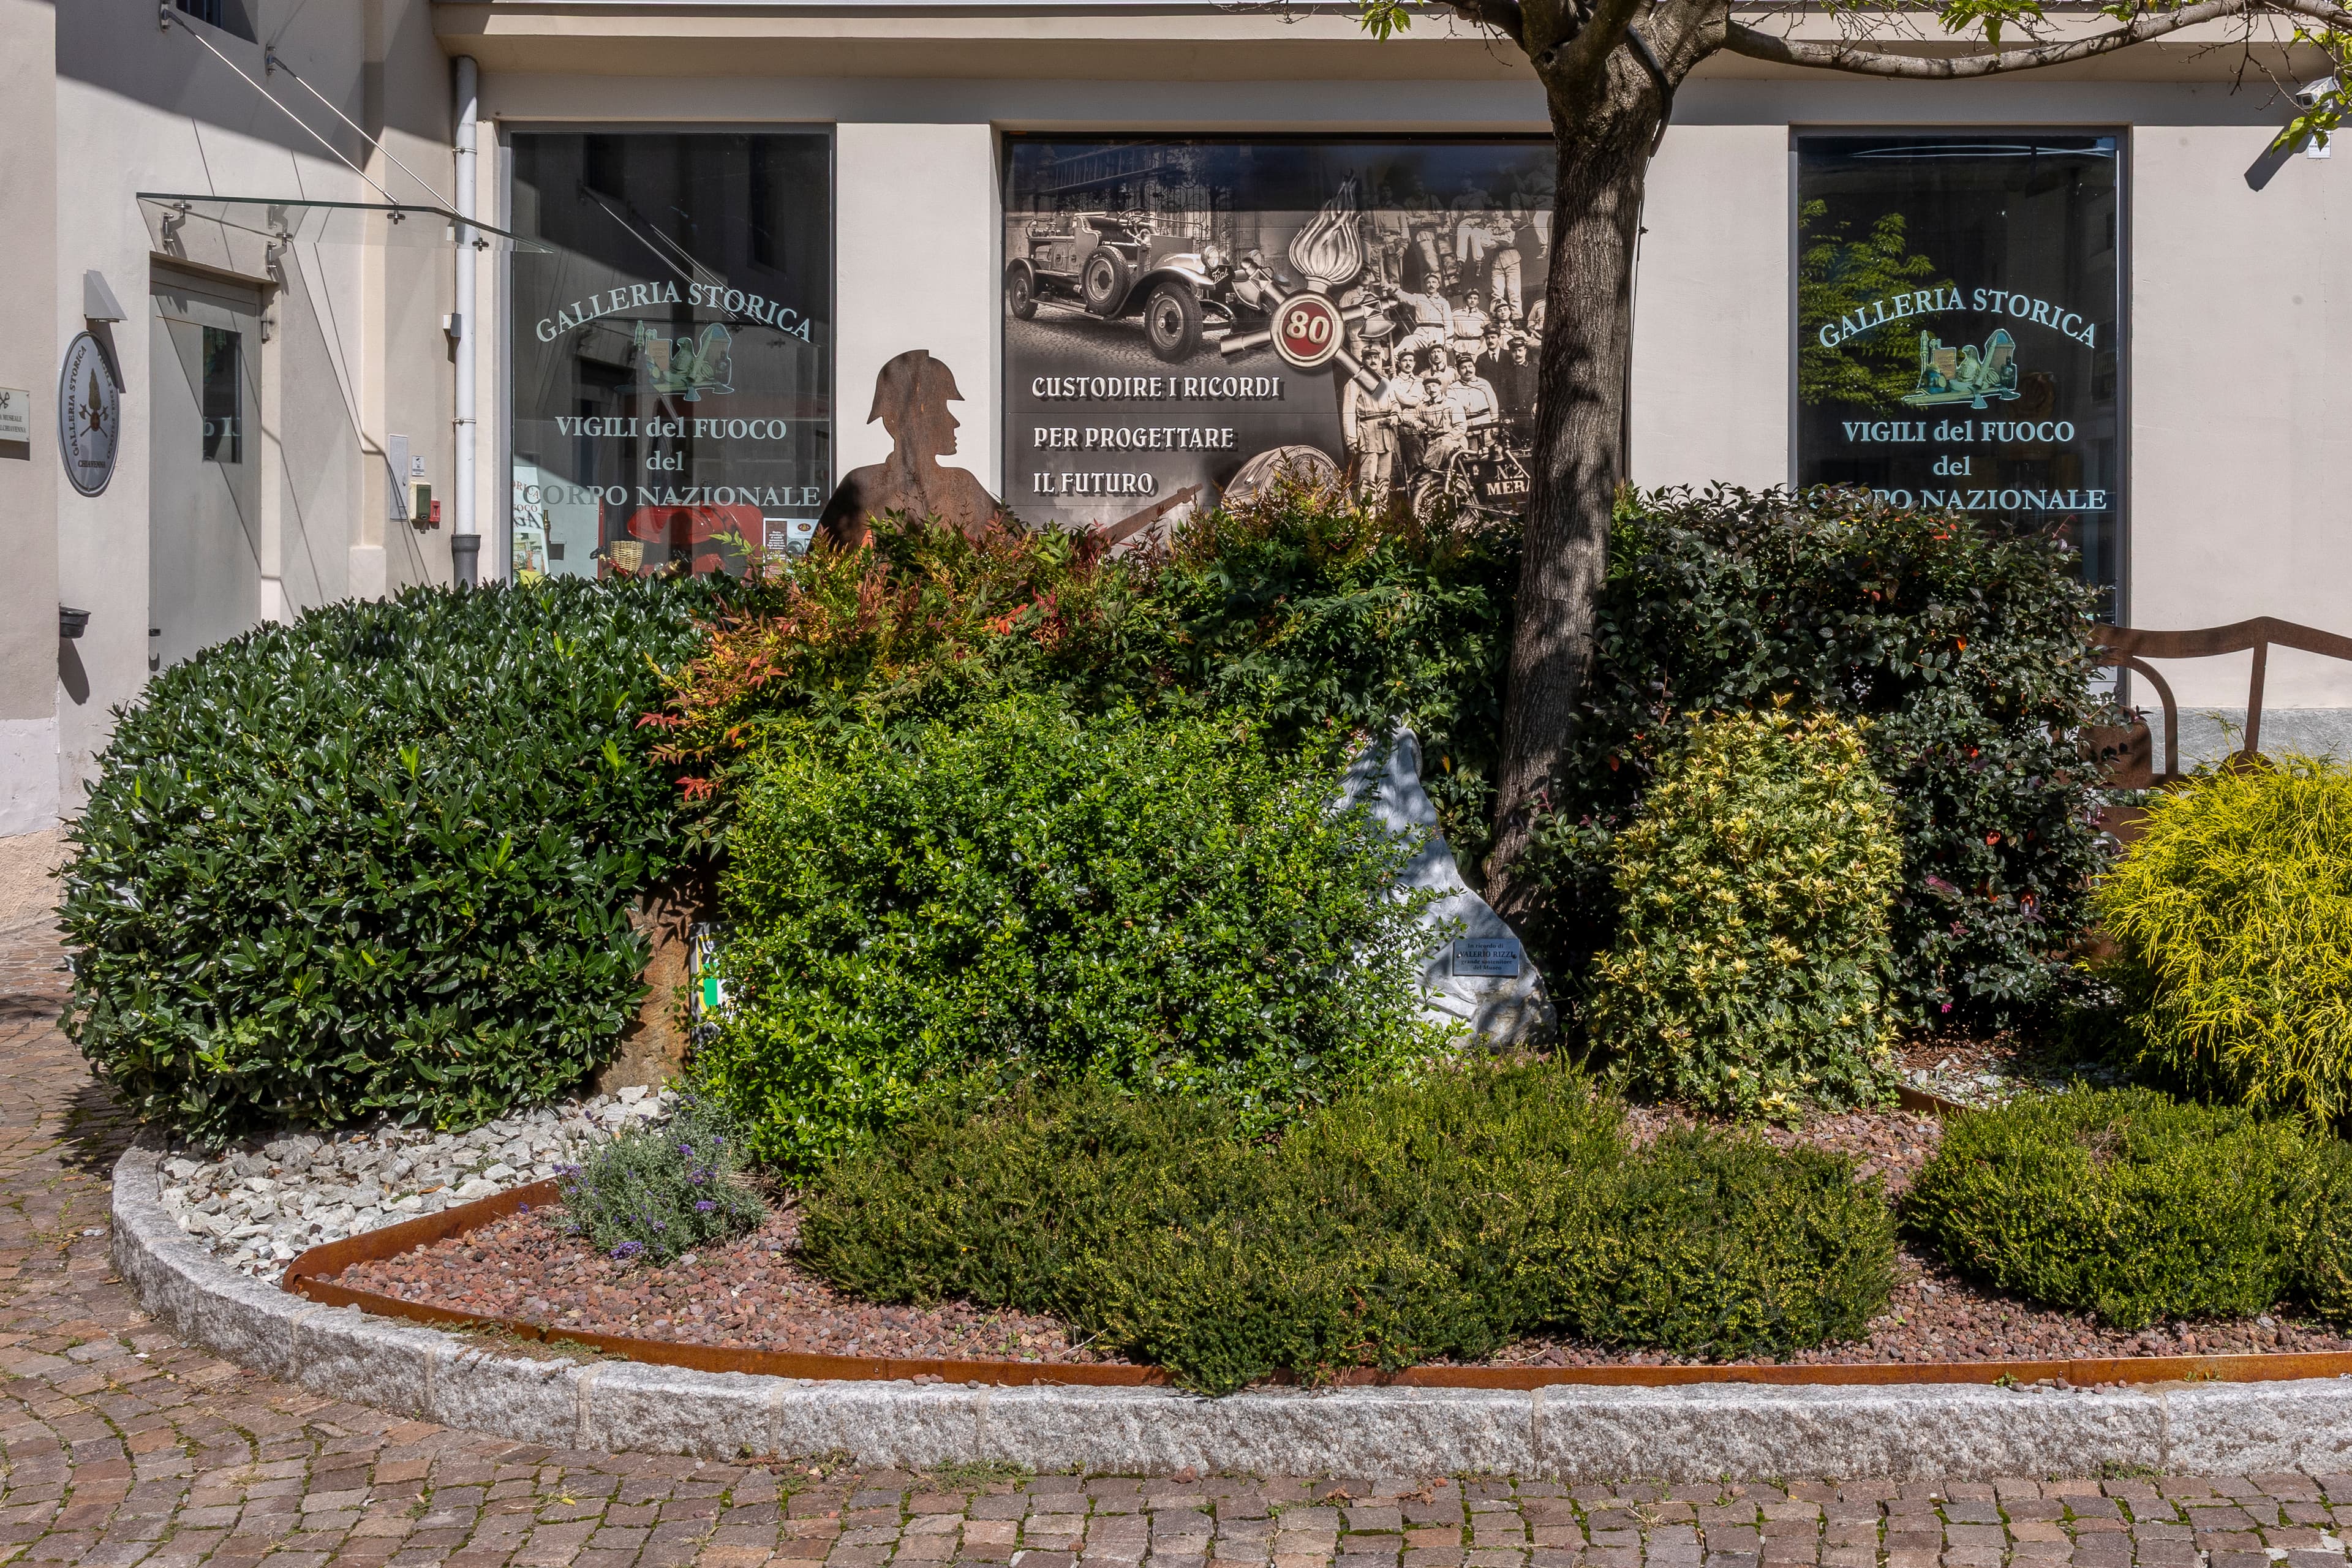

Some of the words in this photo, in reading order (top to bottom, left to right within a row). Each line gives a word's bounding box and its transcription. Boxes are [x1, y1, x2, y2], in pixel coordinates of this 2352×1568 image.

[536, 280, 682, 342] GALLERIA
[687, 282, 811, 343] STORICA
[1819, 287, 1967, 348] GALLERIA
[1973, 288, 2095, 349] STORICA
[1286, 311, 1330, 344] 80
[69, 345, 87, 392] STORICA
[1031, 376, 1162, 398] CUSTODIRE
[1169, 377, 1178, 398] I
[1183, 376, 1280, 398] RICORDI
[69, 395, 79, 456] GALLERIA
[555, 417, 638, 437] VIGILI
[646, 416, 686, 438] del
[693, 418, 787, 440] FUOCO
[1842, 421, 1926, 442] VIGILI
[1934, 419, 1974, 442] del
[1981, 421, 2075, 442] FUOCO
[1033, 427, 1079, 449] PER
[1085, 427, 1234, 450] PROGETTARE
[646, 450, 684, 471] del
[1933, 455, 1972, 476] del
[1033, 472, 1055, 494] IL
[1061, 472, 1154, 494] FUTURO
[1486, 480, 1530, 496] MER
[522, 484, 628, 507] CORPO
[636, 486, 821, 507] NAZIONALE
[1920, 489, 2107, 510] NAZIONALE
